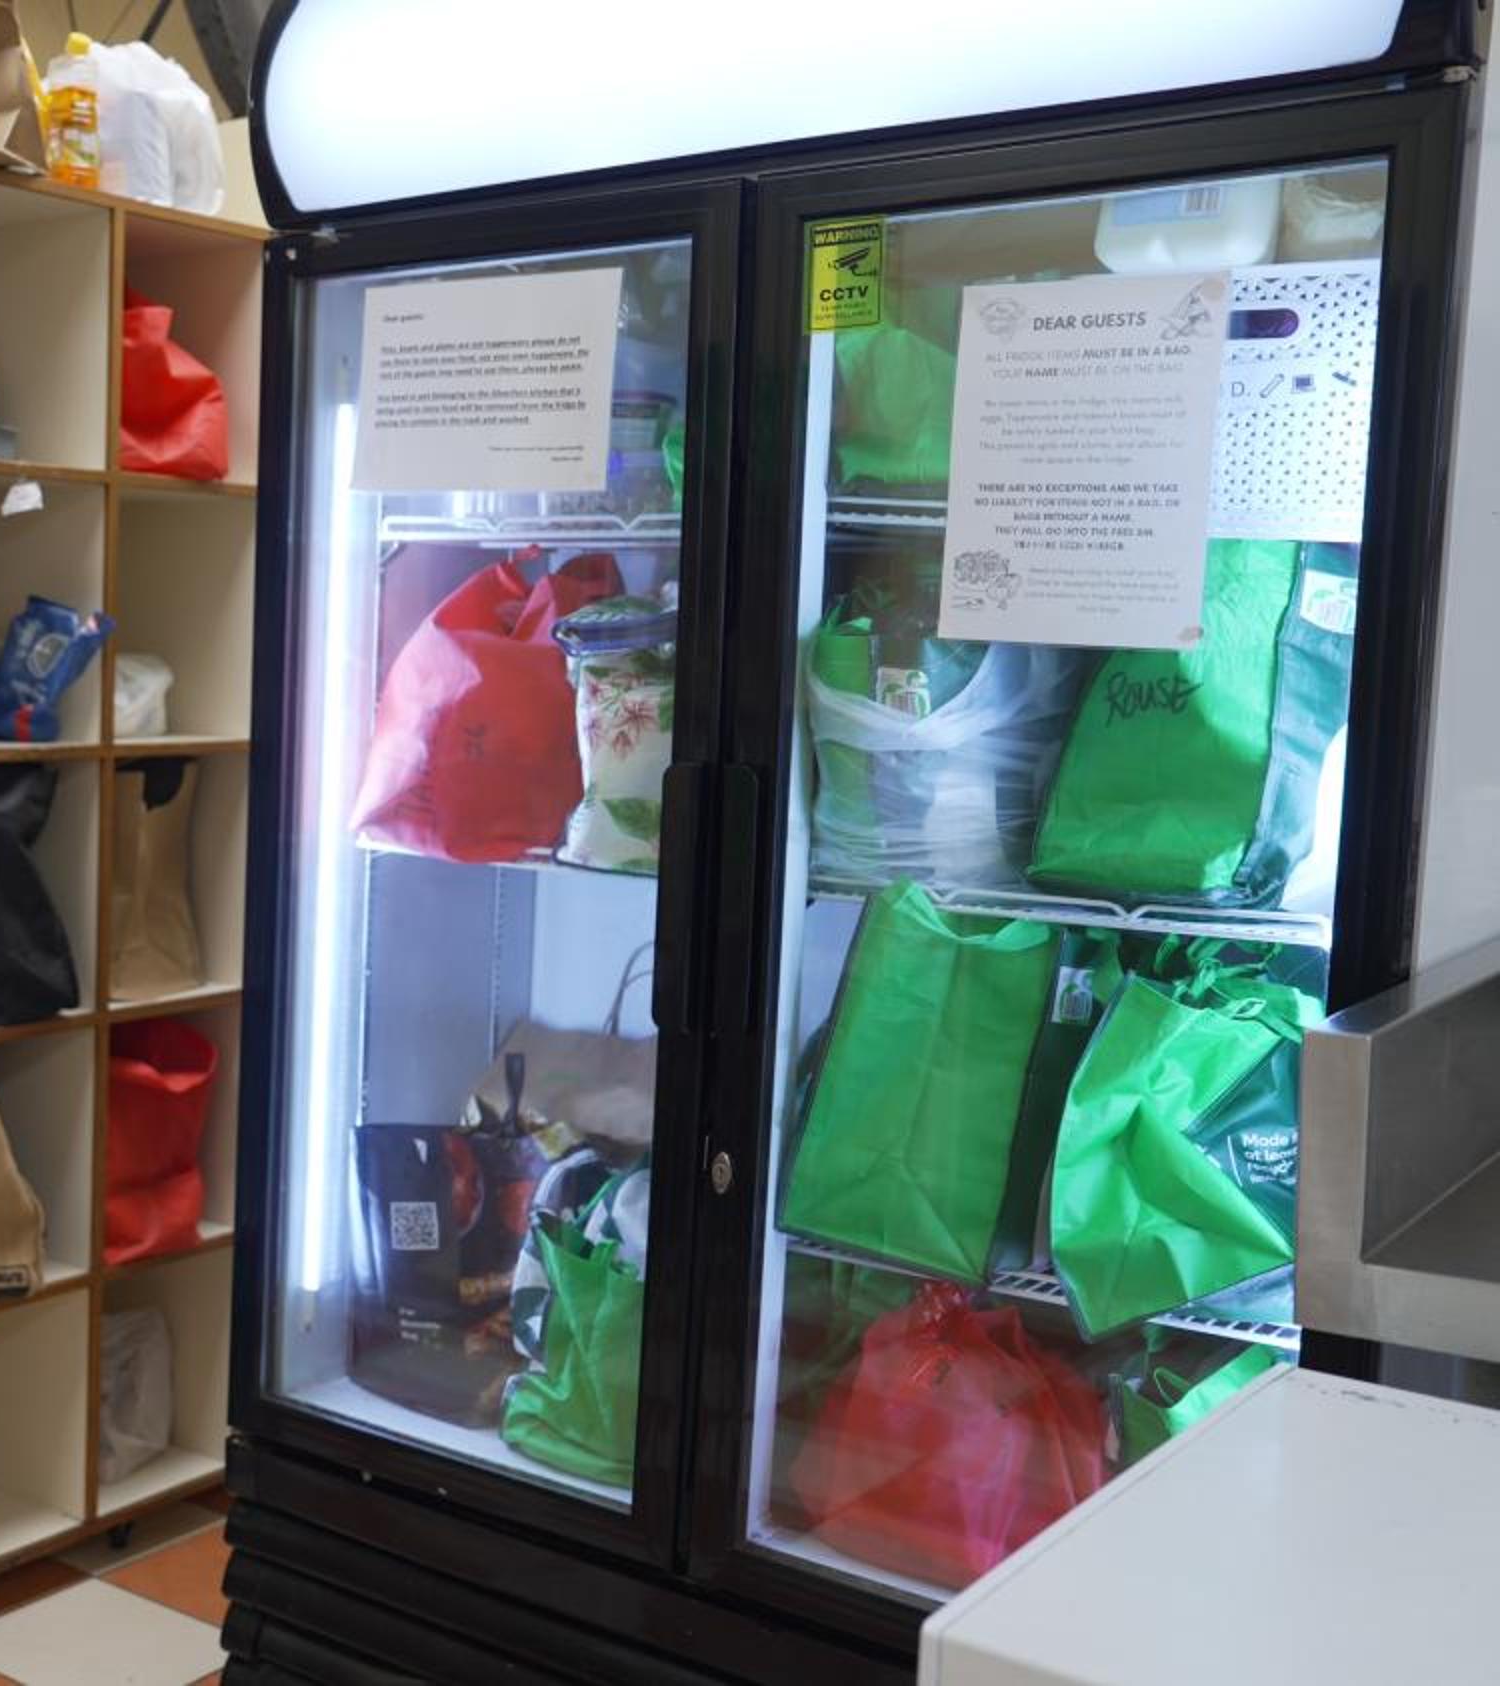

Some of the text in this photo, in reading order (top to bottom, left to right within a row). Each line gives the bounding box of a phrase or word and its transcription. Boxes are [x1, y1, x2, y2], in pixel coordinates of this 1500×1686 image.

[815, 226, 879, 245] WARNING
[819, 285, 869, 302] CCTV
[1033, 312, 1147, 331] DEAR GUESTS
[1082, 348, 1117, 359] MUST
[1120, 347, 1133, 357] BE
[1137, 347, 1149, 357] IN
[1153, 346, 1161, 356] A
[1025, 367, 1058, 377] NAME
[1241, 1133, 1289, 1148] Made
